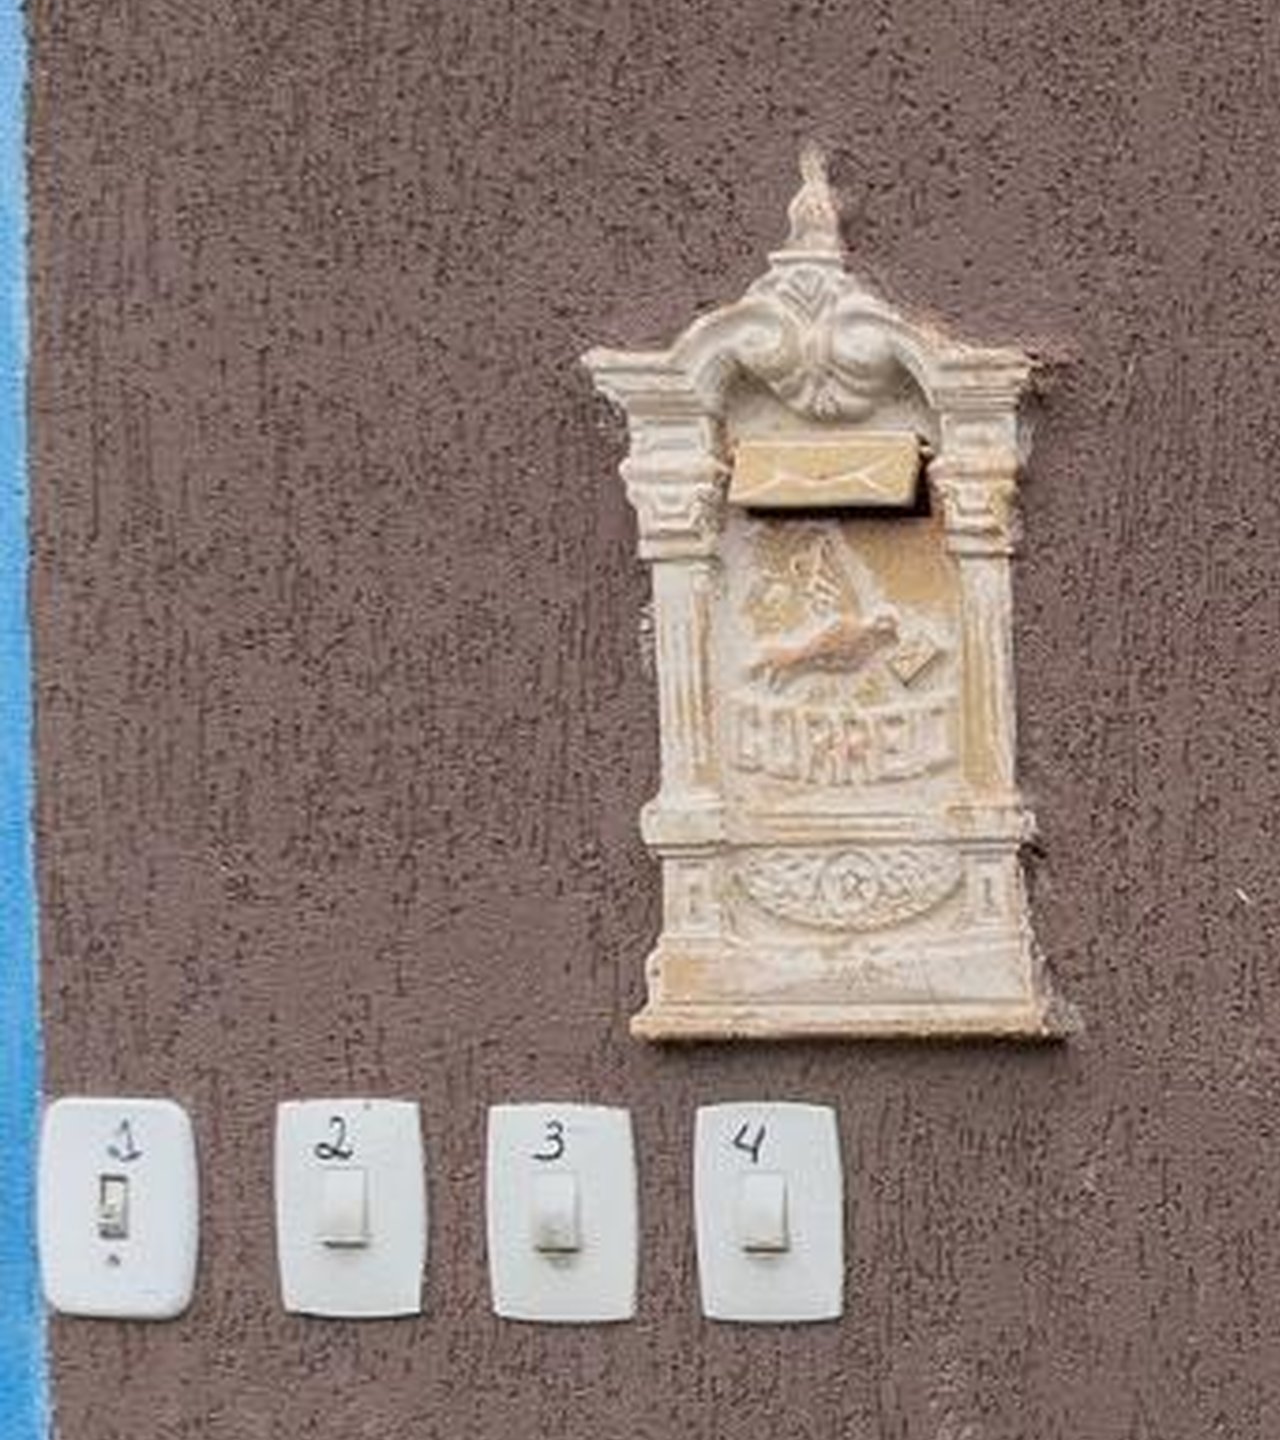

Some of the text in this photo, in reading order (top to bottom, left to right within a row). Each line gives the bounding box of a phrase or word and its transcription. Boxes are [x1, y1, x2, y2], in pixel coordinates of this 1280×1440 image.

[313, 1115, 355, 1161] 2
[531, 1120, 566, 1162] 3
[731, 1122, 767, 1164] 4
